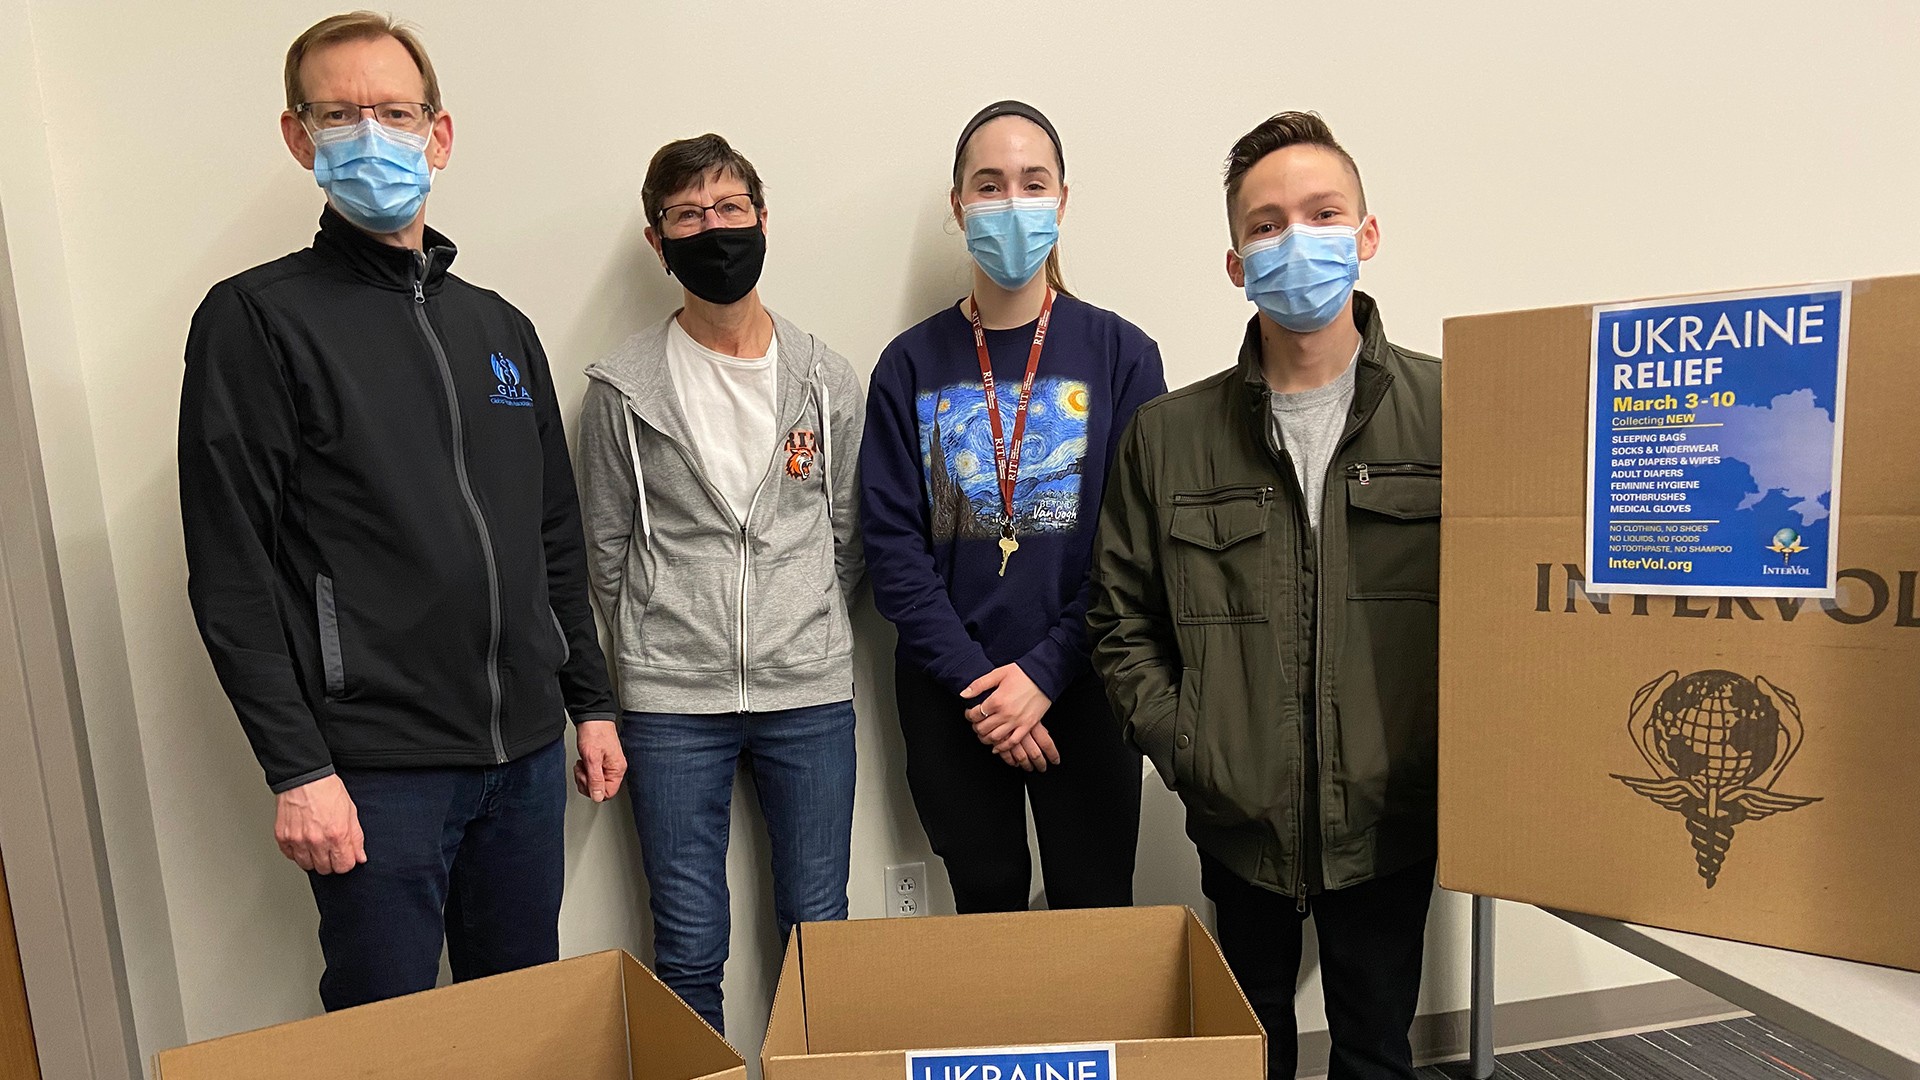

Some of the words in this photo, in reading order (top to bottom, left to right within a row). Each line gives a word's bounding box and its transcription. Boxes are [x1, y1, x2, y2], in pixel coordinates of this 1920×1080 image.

[972, 310, 981, 327] RIT
[1033, 327, 1045, 346] RIT
[1611, 304, 1824, 358] UKRAINE
[983, 370, 994, 388] RIT
[1613, 357, 1723, 390] RELIEF
[497, 384, 530, 398] GHA
[1018, 392, 1029, 411] RIT
[1613, 397, 1677, 412] March
[1684, 391, 1735, 409] 3-10
[1611, 415, 1664, 427] Collecting
[1666, 413, 1695, 424] NEW
[1611, 434, 1657, 444] SLEEPING
[1659, 433, 1687, 442] BAGS
[995, 437, 1006, 457] RIT
[1611, 446, 1643, 455] SOCKS
[1645, 446, 1653, 454] &
[1655, 443, 1719, 454] UNDERWEAR
[1611, 458, 1636, 467] BABY
[1638, 457, 1678, 466] DIAPERS
[1680, 457, 1688, 465] &
[1689, 456, 1721, 465] WIPES
[1007, 461, 1018, 481] RIT
[1611, 470, 1641, 479] ADULT
[1643, 469, 1684, 478] DIAPERS
[1610, 481, 1655, 490] FEMININE
[1656, 480, 1700, 489] HYGIENE
[1610, 493, 1686, 502] TOOTHBRUSHES
[1033, 505, 1053, 520] Van
[1054, 505, 1078, 522] Gogh
[1609, 505, 1651, 513] MEDICAL
[1653, 504, 1692, 513] GLOVES
[1623, 525, 1664, 533] CLOTHING,
[1674, 545, 1688, 553] NO
[1689, 545, 1733, 553] SHAMPOO
[1608, 557, 1692, 572] InterVol.org
